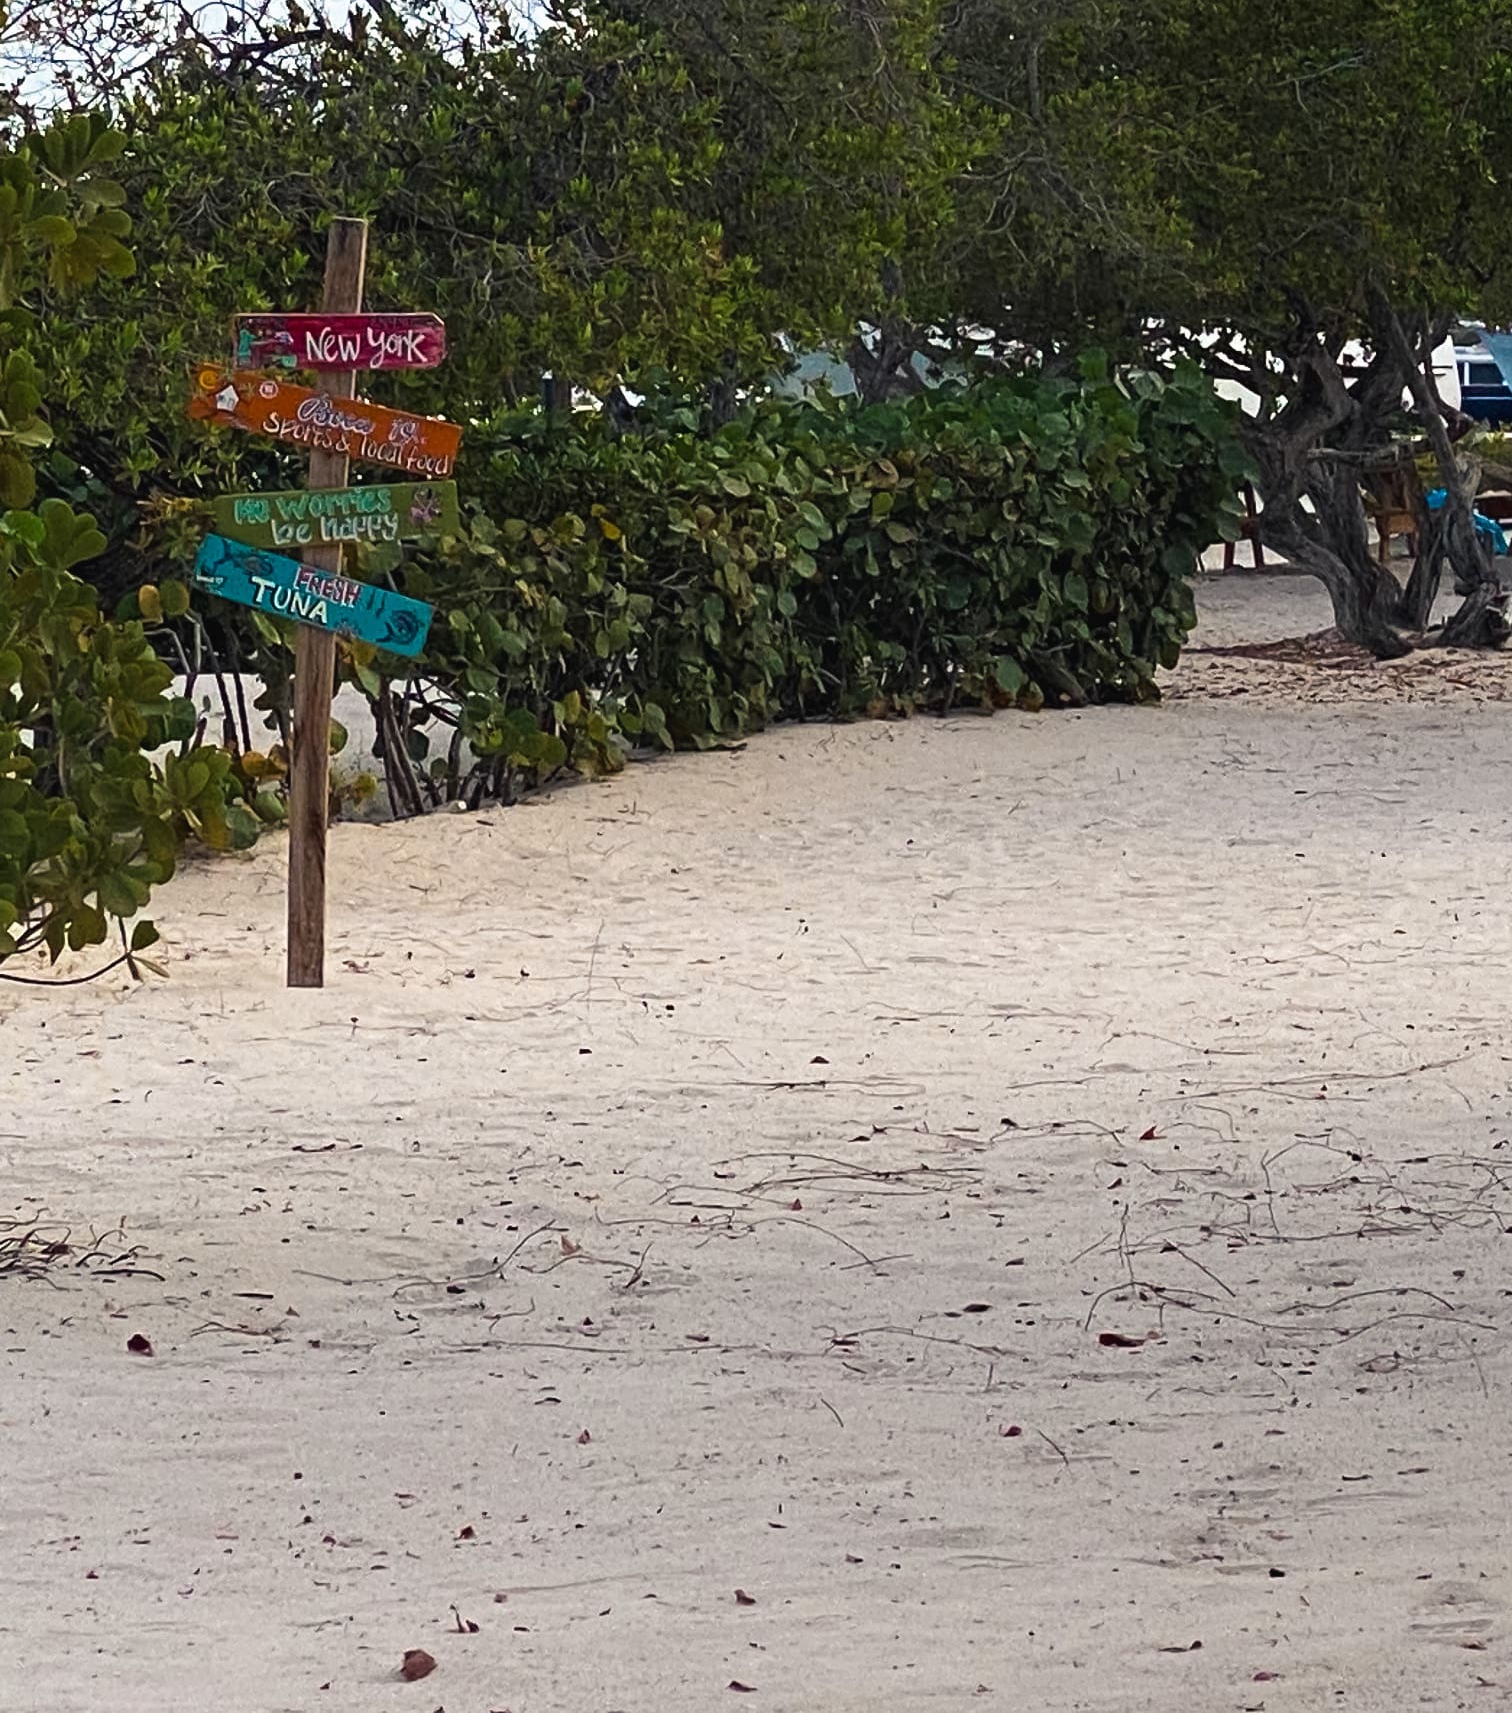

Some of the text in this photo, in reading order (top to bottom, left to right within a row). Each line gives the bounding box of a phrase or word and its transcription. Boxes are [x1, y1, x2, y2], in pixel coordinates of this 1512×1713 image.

[307, 327, 360, 361] New
[262, 411, 333, 451] Sports
[360, 434, 403, 466] local
[407, 446, 448, 475] food
[271, 518, 312, 545] be
[251, 575, 329, 625] TUNA
[293, 565, 362, 609] FRESH
